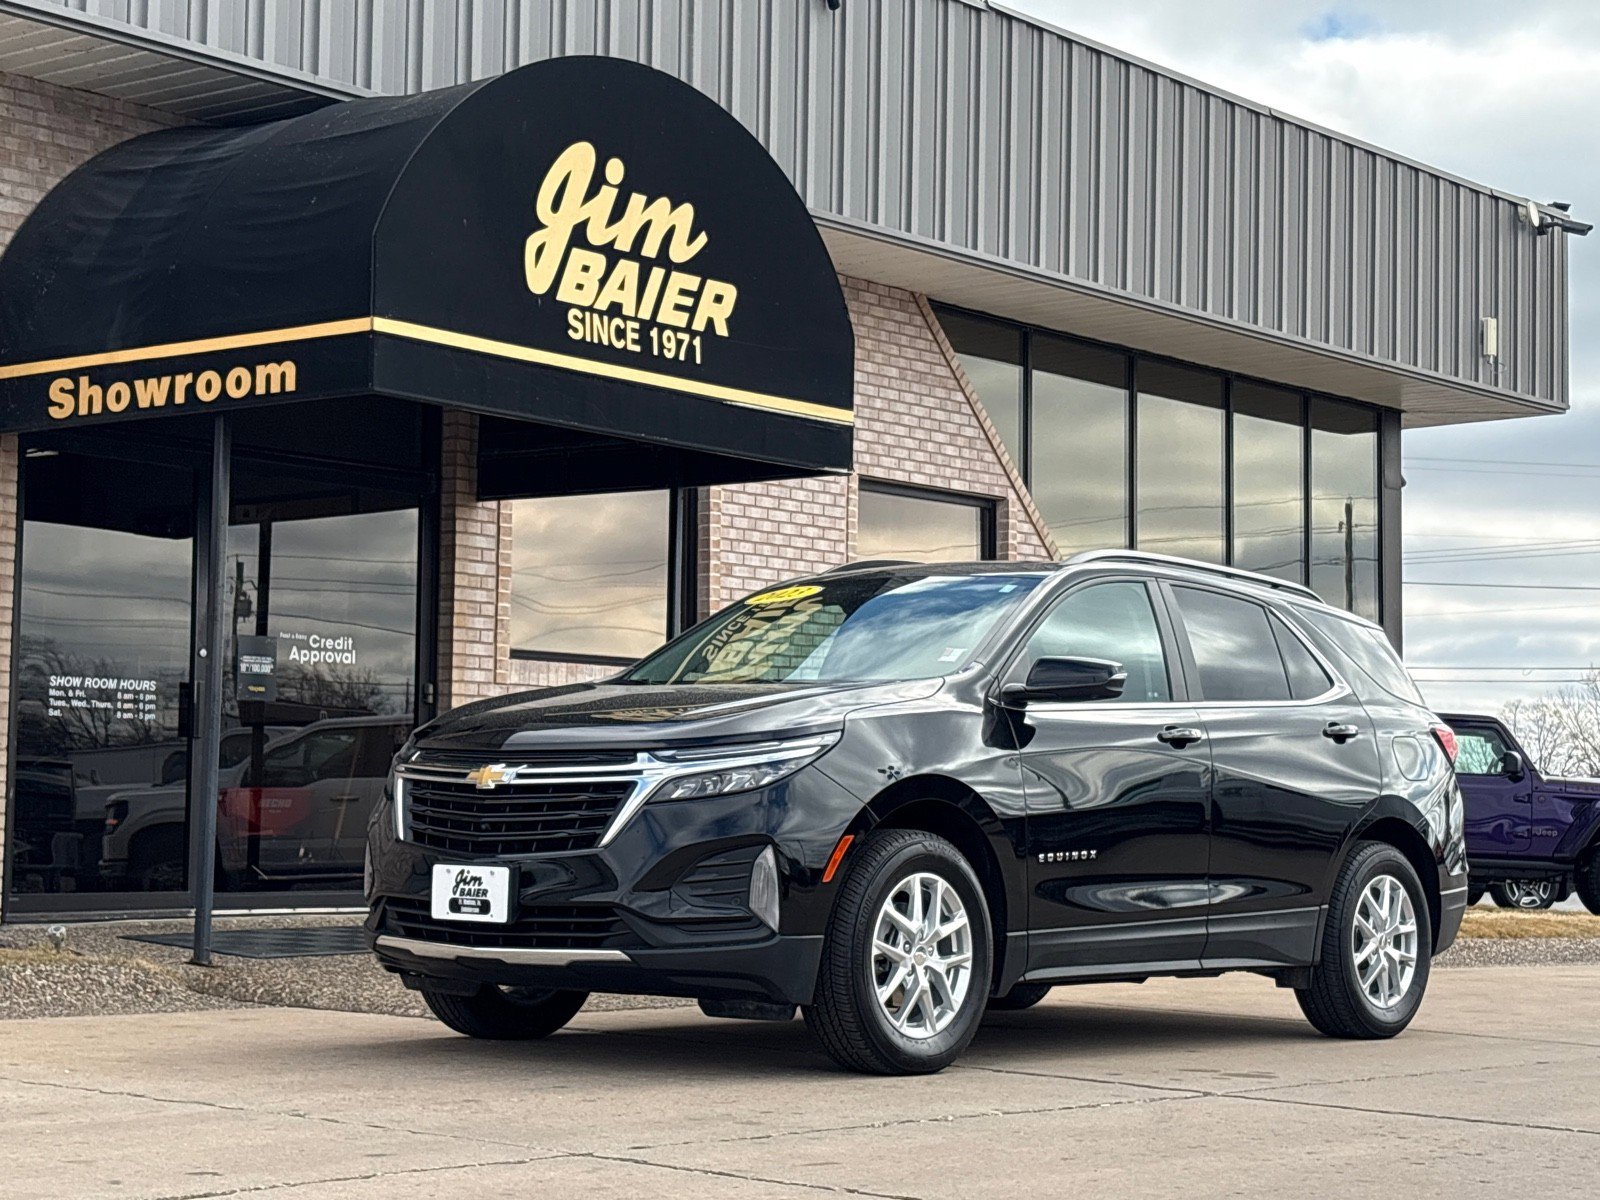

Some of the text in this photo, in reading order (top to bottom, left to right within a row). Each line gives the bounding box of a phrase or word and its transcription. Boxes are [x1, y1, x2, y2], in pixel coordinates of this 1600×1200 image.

[525, 141, 708, 295] Jim
[556, 247, 738, 337] BAIER
[567, 307, 701, 364] SINCE 1971
[48, 360, 297, 420] Showroom
[309, 634, 353, 650] Credit
[289, 645, 356, 665] Approval
[49, 675, 157, 691] SHOW ROOM HOURS
[48, 688, 66, 697] Mon.
[1536, 828, 1558, 837] Jeep
[1038, 850, 1097, 863] EQUINOX
[452, 868, 483, 896] Jim
[459, 887, 488, 897] BAIER
